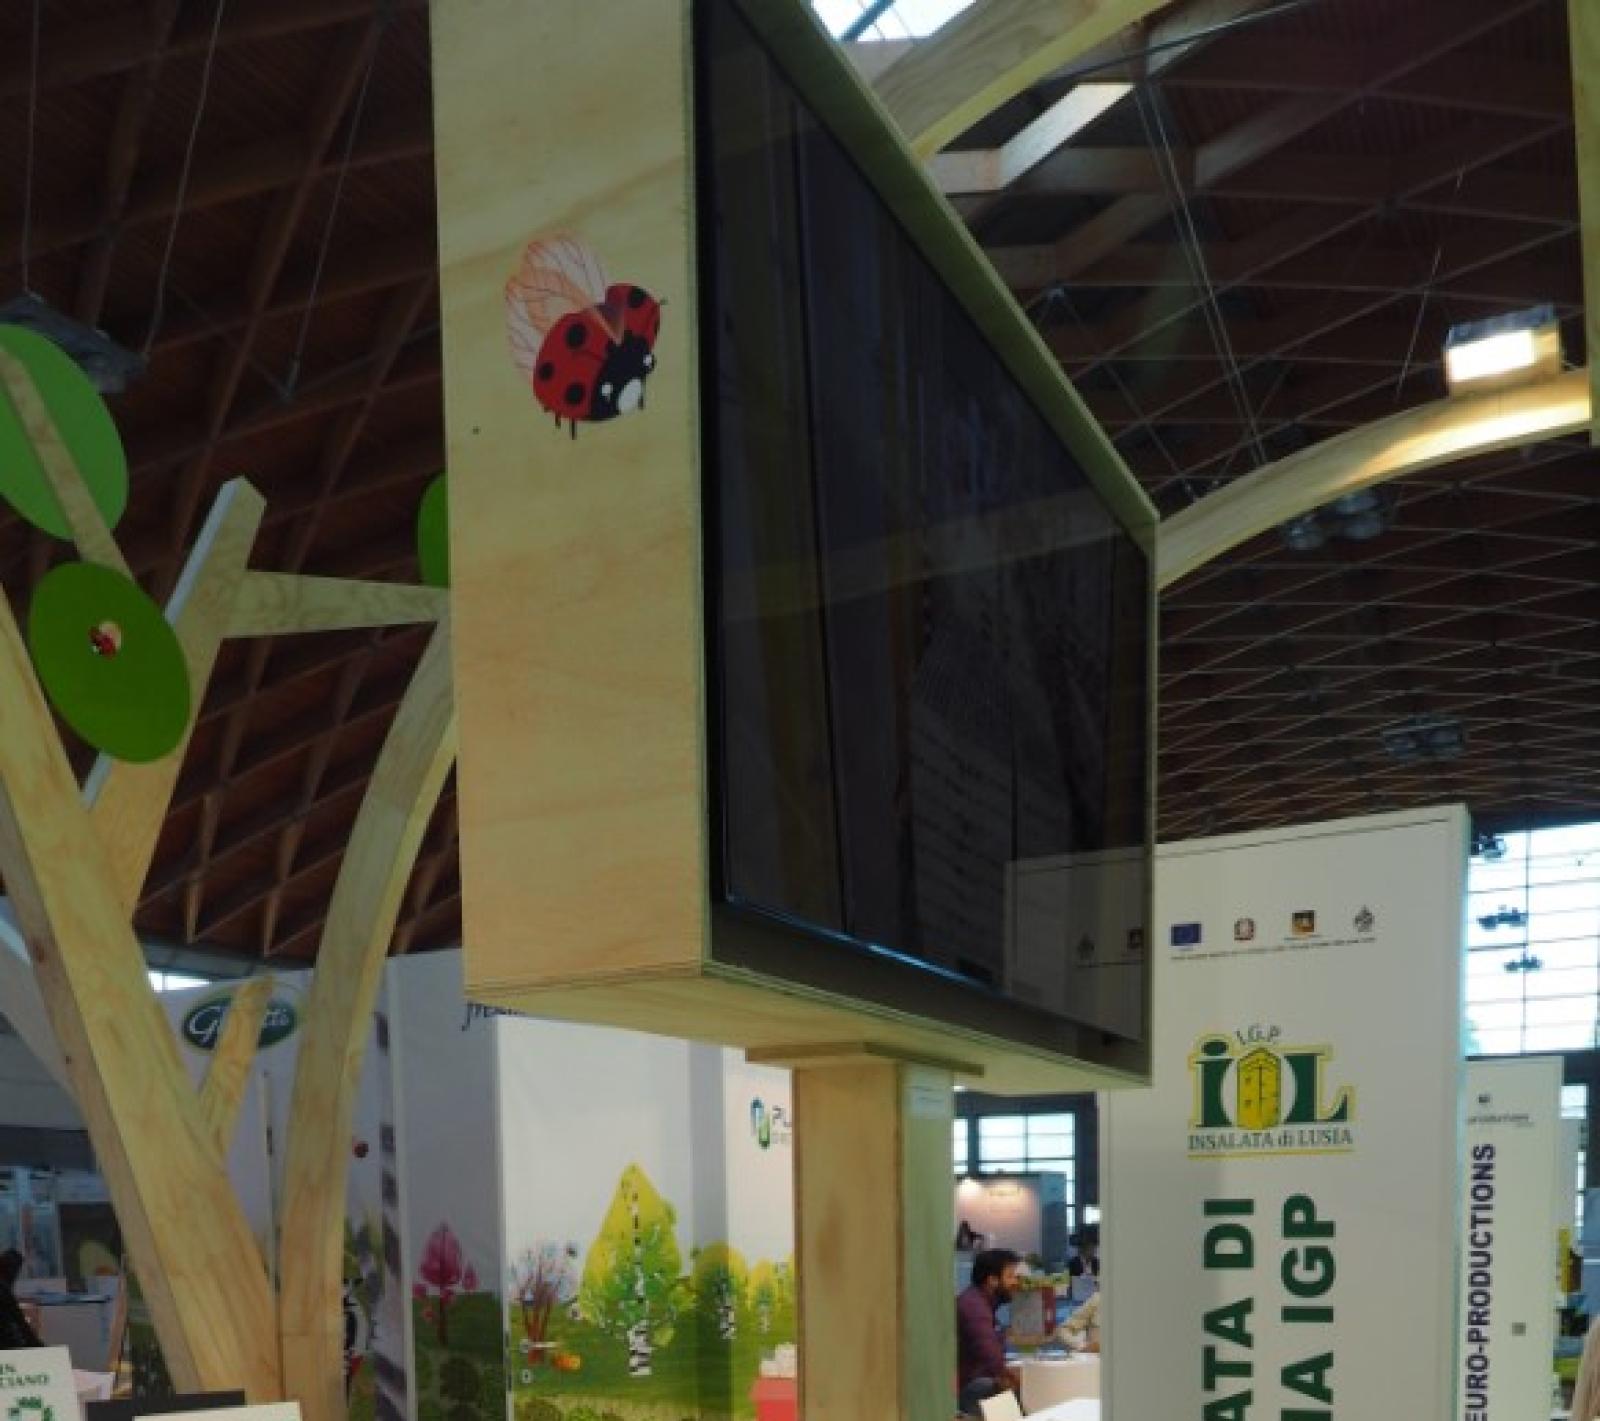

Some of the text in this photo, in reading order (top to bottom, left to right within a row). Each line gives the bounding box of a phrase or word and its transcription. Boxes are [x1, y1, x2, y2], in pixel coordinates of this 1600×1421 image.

[1188, 1127, 1354, 1150] INSALATA di LUSIA
[1203, 1199, 1254, 1269] DI
[1281, 1193, 1336, 1323] IGP
